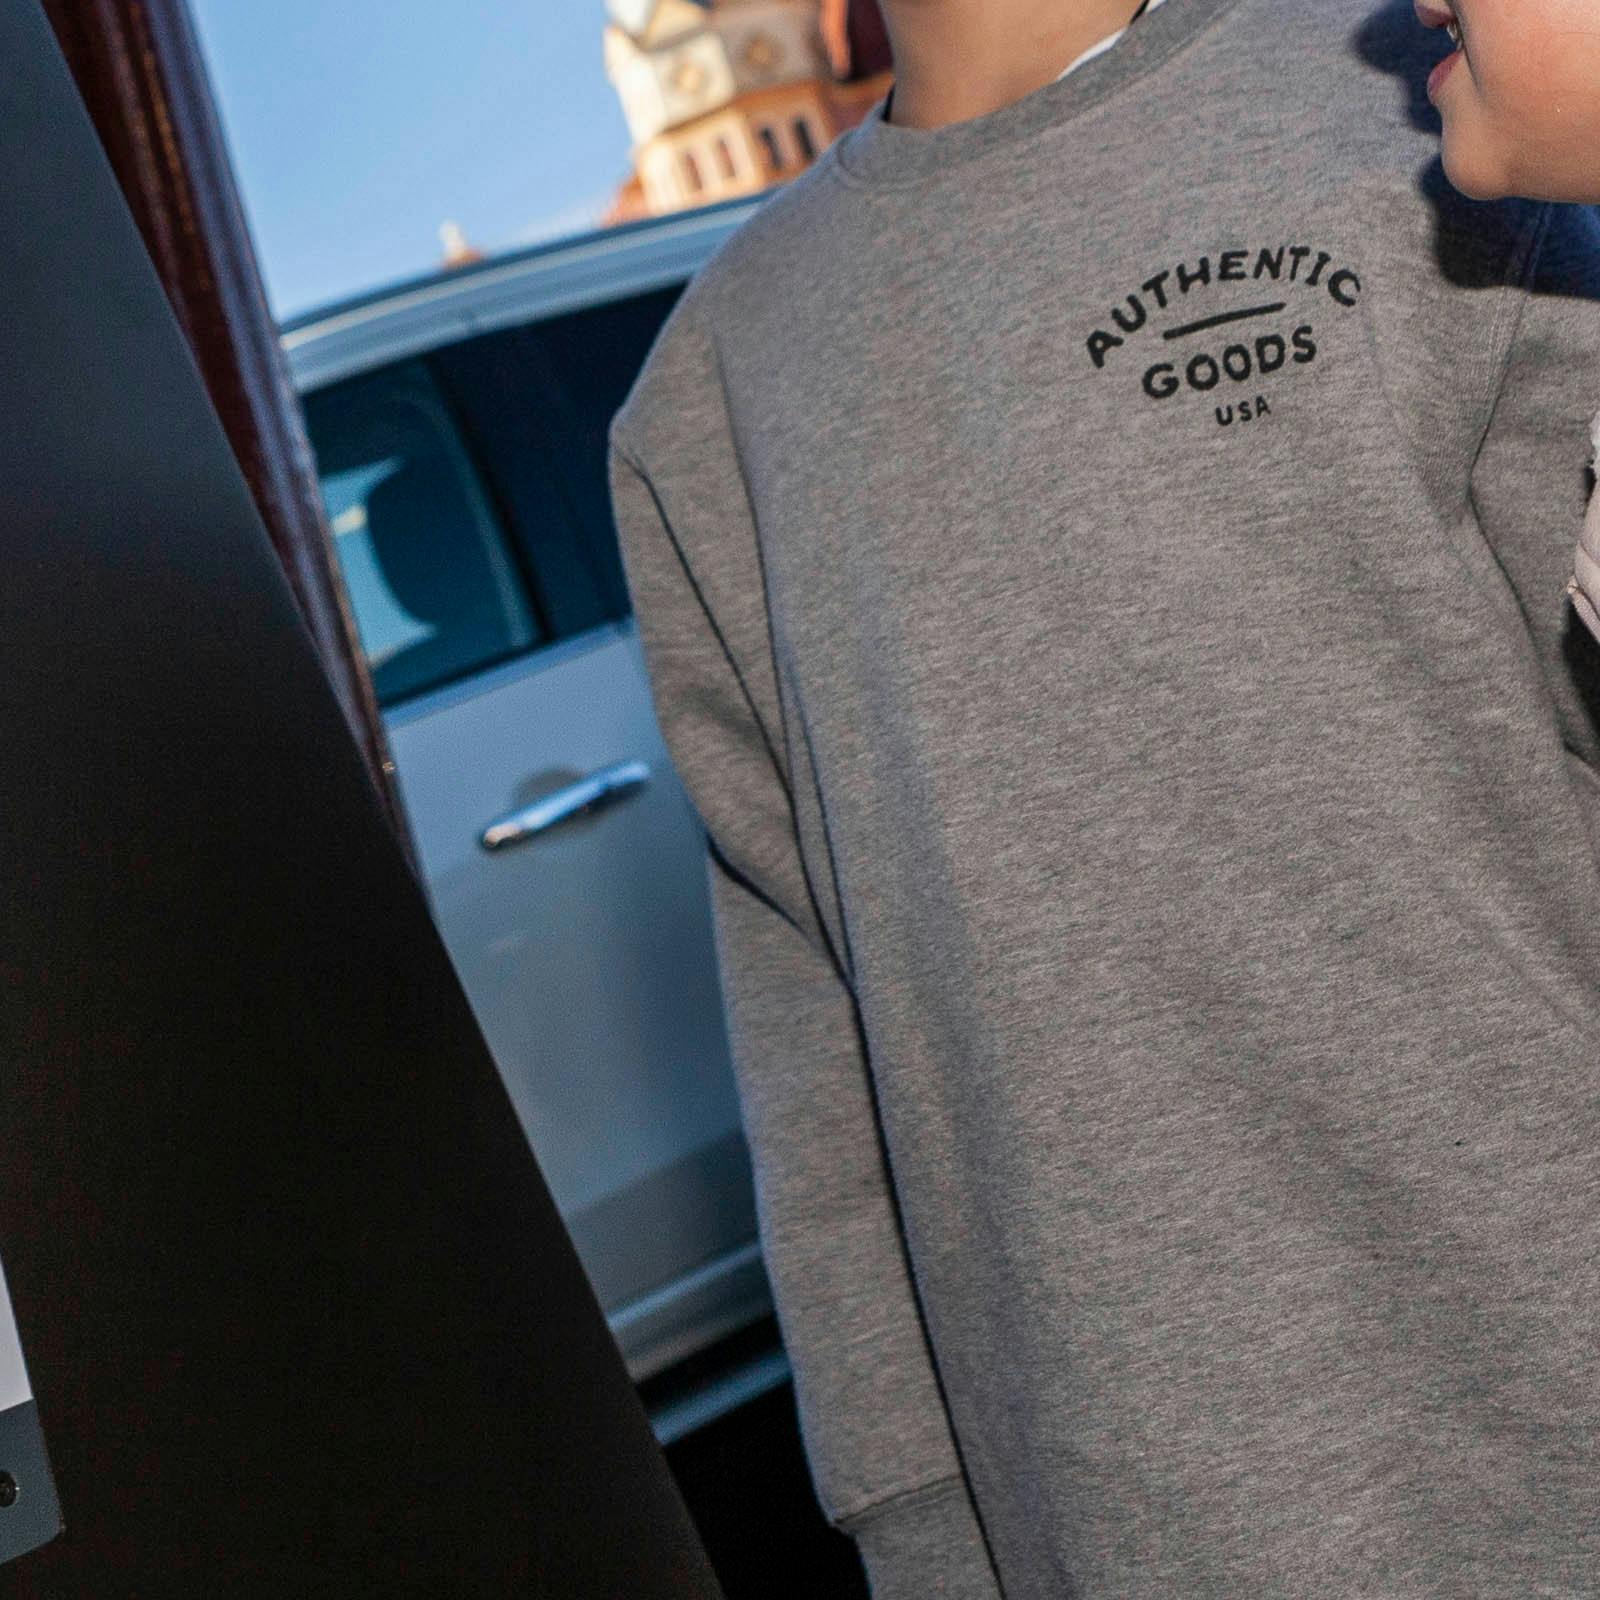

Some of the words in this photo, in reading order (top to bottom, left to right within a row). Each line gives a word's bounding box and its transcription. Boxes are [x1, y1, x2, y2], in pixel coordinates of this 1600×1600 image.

[1086, 246, 1362, 369] AUTHENTIC
[1142, 324, 1318, 399] GOODS
[1215, 395, 1272, 427] USA
